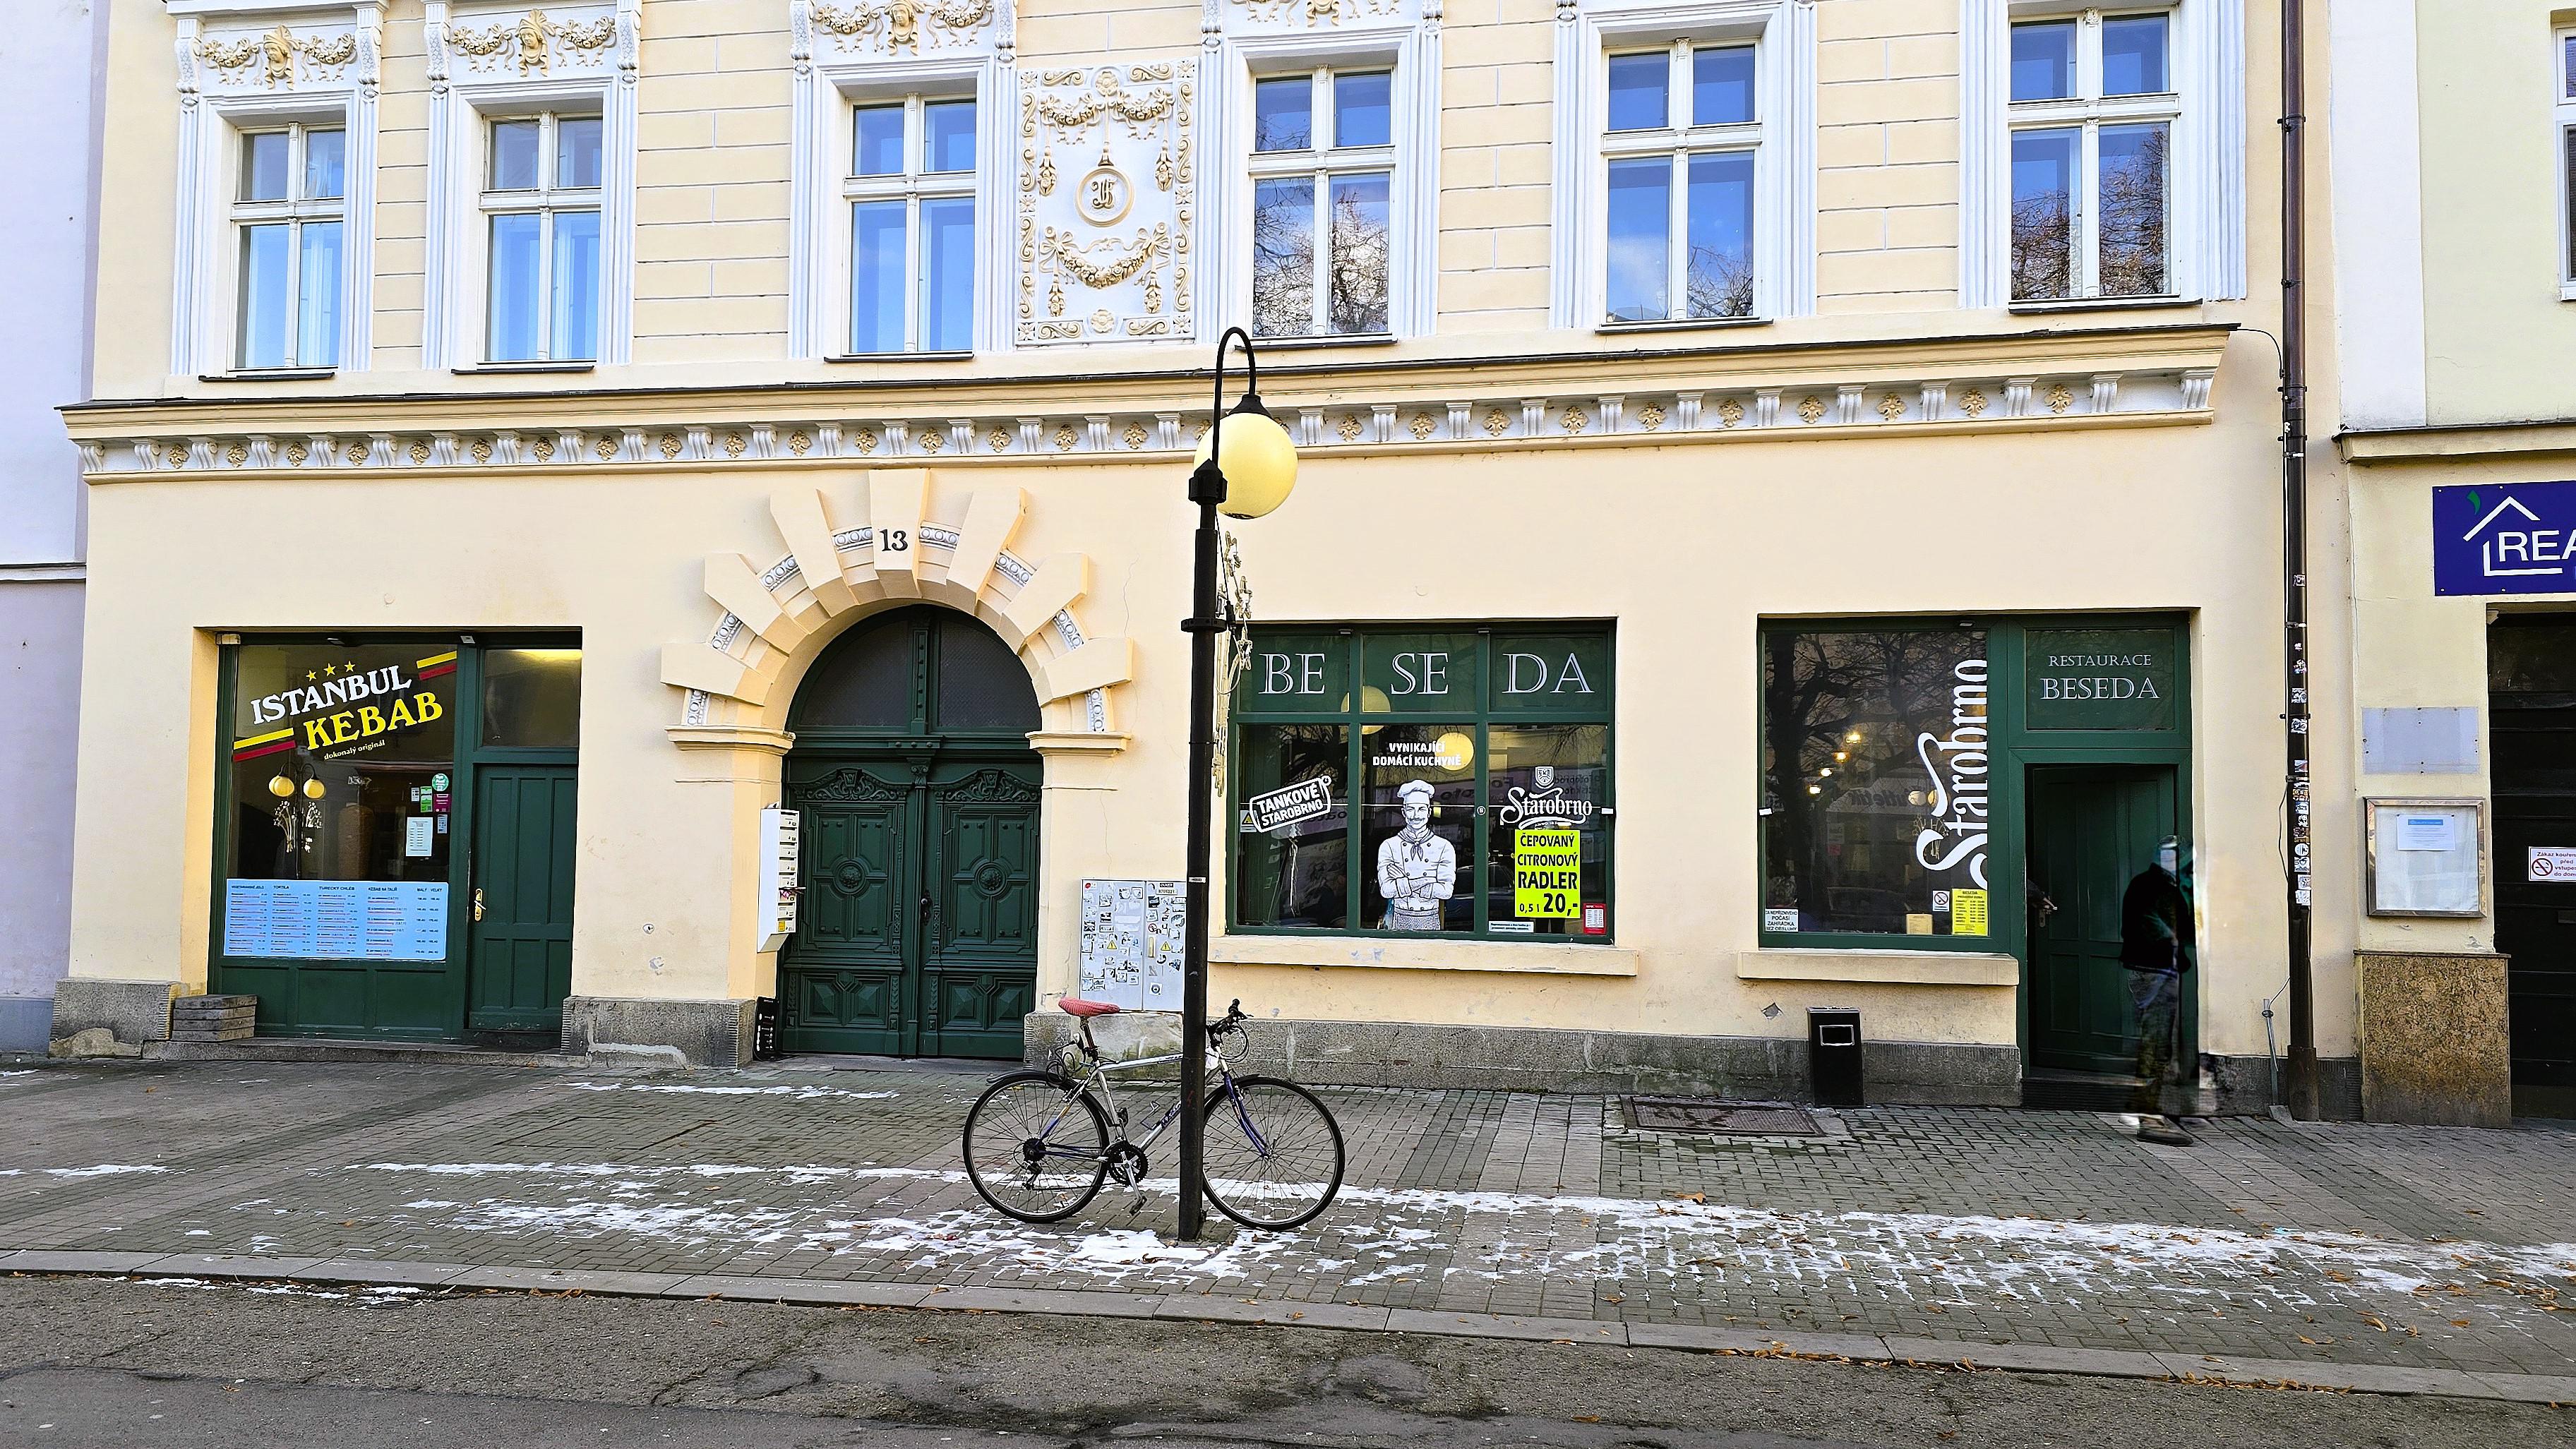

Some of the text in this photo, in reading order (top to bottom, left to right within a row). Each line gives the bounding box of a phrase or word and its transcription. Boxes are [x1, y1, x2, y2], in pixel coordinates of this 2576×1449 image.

[879, 529, 909, 552] 13
[2049, 654, 2152, 667] RESTAURACE
[1258, 653, 1595, 695] BE SE DA
[251, 665, 412, 725] ISTANBUL
[2040, 677, 2160, 699] BESEDA
[303, 692, 443, 750] KEBAB
[324, 740, 385, 761] dokonalý originál
[1389, 740, 1446, 753] VYNIKAJÍCÍ
[1372, 754, 1462, 766] DOMÁCÍ KUCHYNĚ
[1916, 659, 1988, 891] Starobrno
[1256, 782, 1321, 814] TANKOVÉ
[1500, 787, 1593, 826] Starobrno
[1261, 798, 1324, 826] STAROBRNO
[1520, 832, 1575, 848] ČEPOVANÝ
[1517, 851, 1578, 867] CITRONOVÝ
[1518, 871, 1578, 889] RADLER
[1519, 903, 1534, 914] 0,5
[1543, 893, 1578, 917] 20,-
